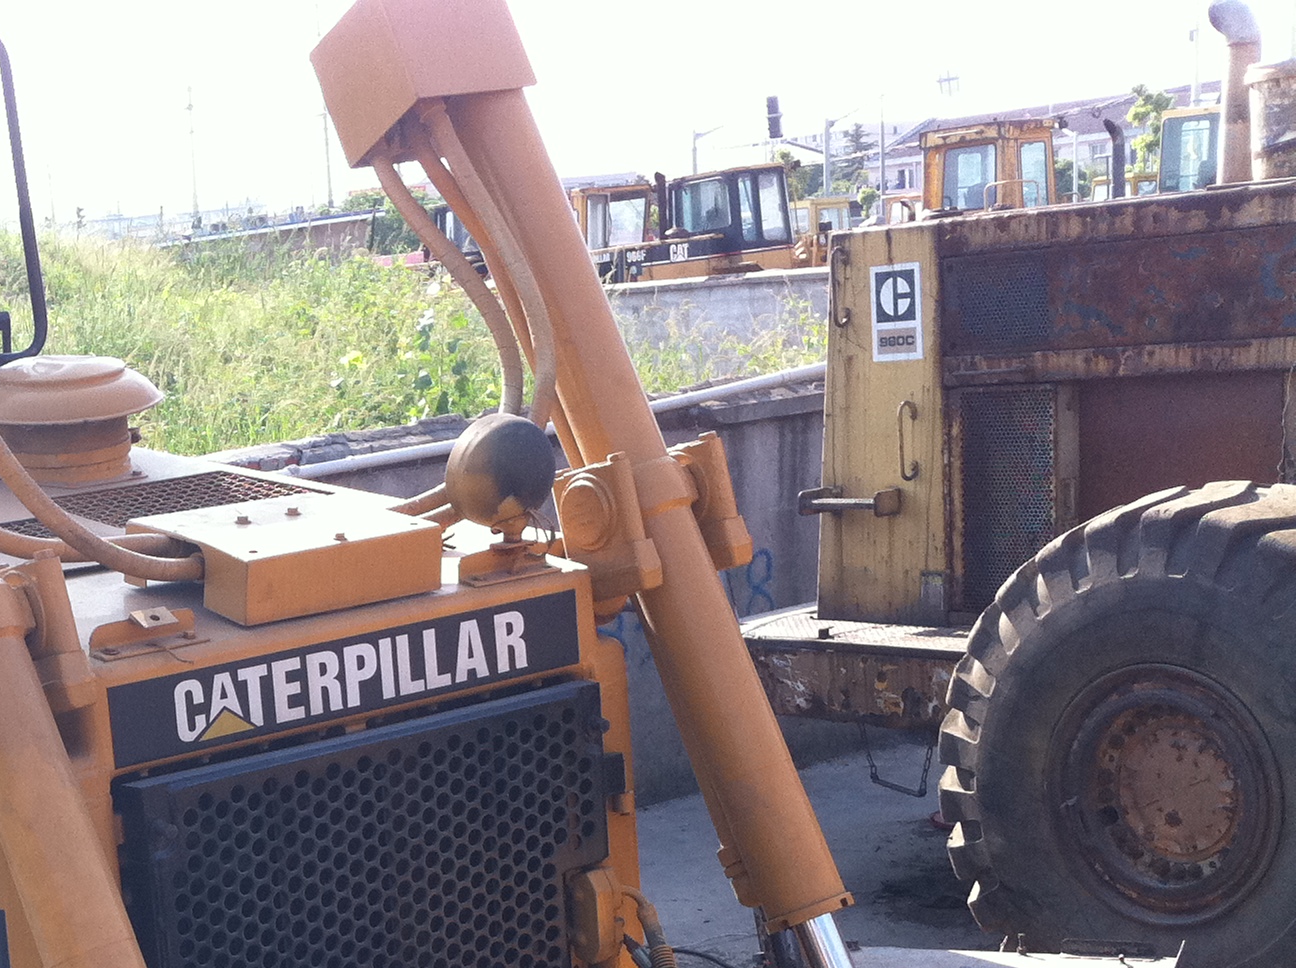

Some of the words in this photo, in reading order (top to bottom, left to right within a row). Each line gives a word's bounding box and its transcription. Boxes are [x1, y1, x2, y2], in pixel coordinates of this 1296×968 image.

[669, 243, 689, 262] CAT
[879, 335, 915, 348] 980C
[173, 610, 529, 743] CATERPILLAR
